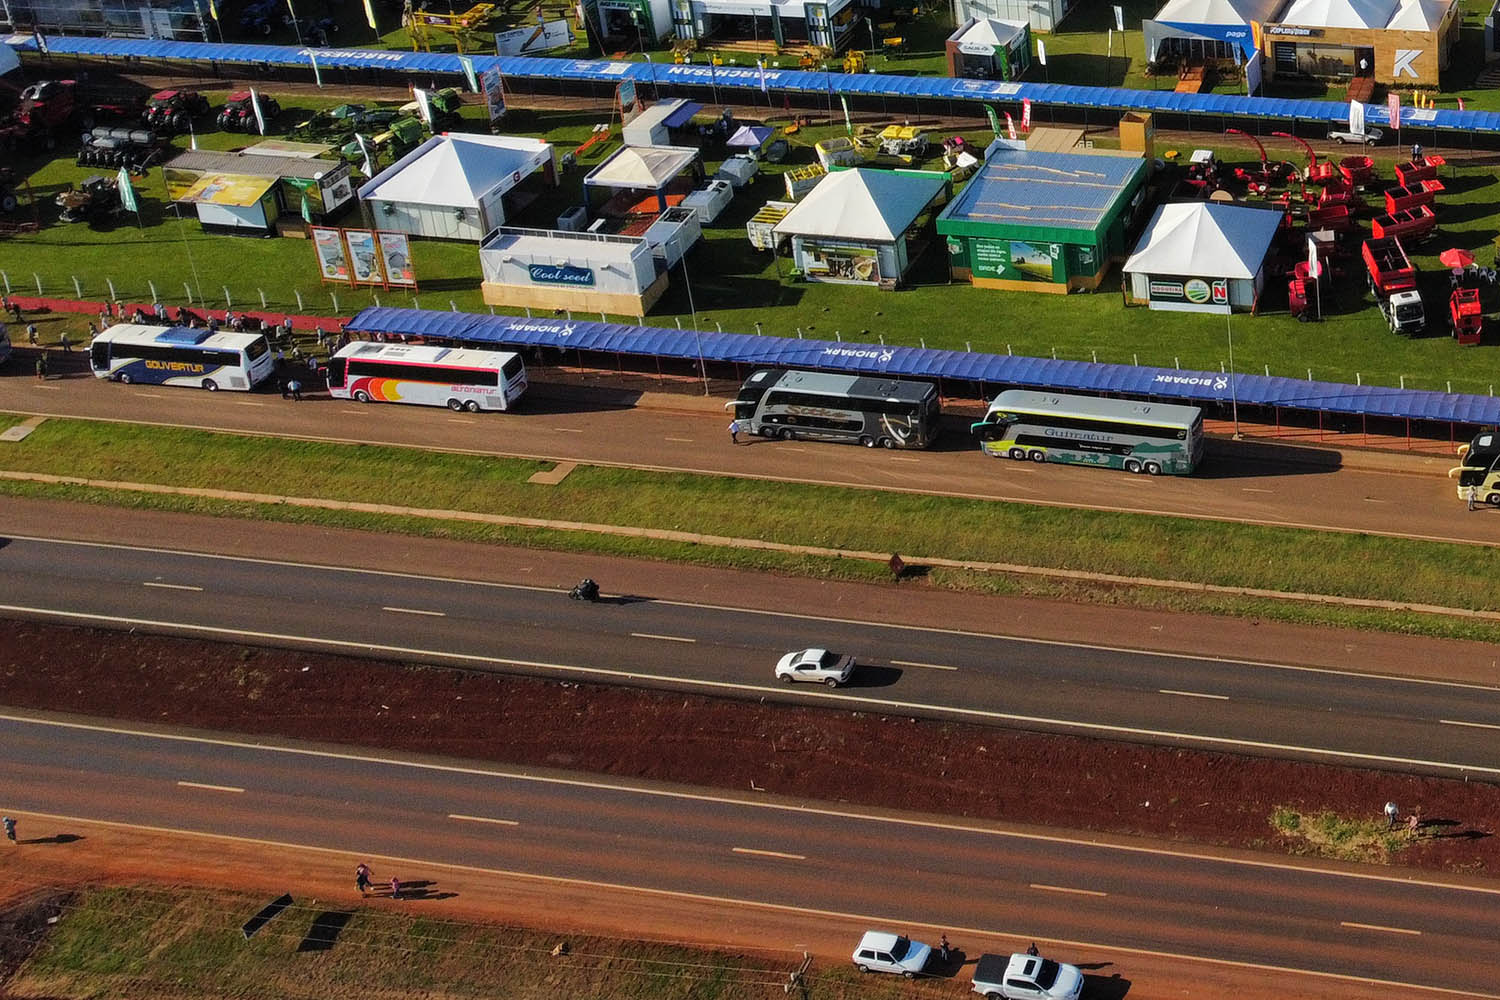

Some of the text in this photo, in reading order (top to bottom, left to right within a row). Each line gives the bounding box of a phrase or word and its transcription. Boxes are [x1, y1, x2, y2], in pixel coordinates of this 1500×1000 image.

[297, 49, 404, 62] MARCHESAN
[1393, 49, 1424, 78] K
[668, 67, 782, 81] MARCHESAN
[530, 266, 592, 283] Cool seed
[508, 323, 561, 334] BIOPARK
[822, 348, 878, 360] BIOPARK
[1155, 375, 1211, 388] BIOPARK
